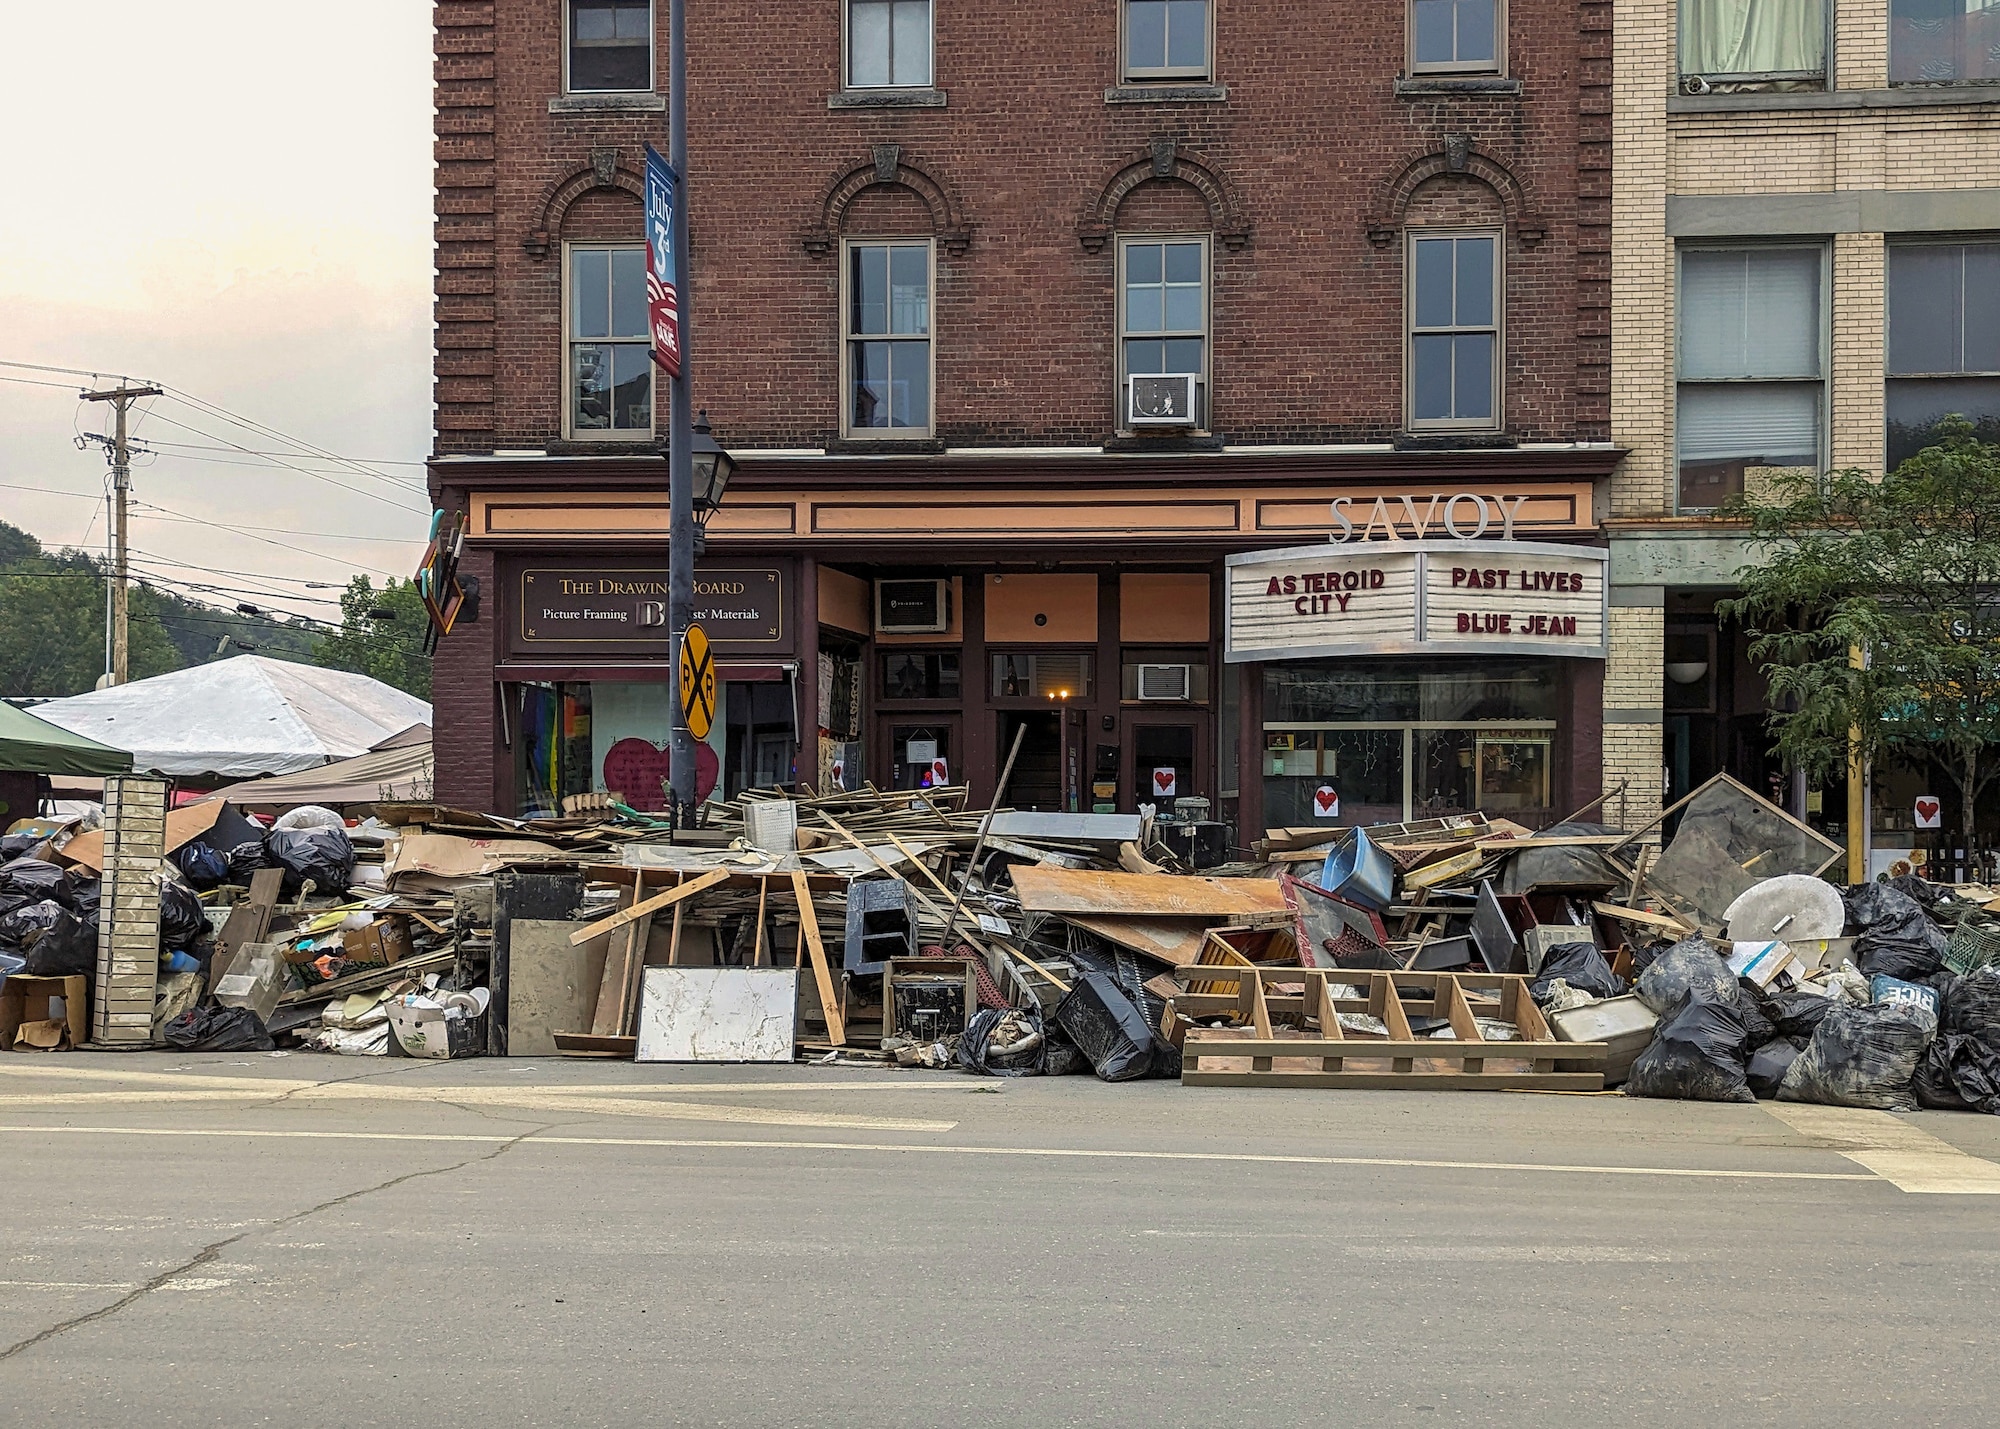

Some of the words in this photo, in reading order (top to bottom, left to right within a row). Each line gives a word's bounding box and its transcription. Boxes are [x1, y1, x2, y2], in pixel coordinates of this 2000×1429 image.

[649, 180, 673, 235] July
[1329, 493, 1530, 543] SAVOY
[559, 579, 593, 595] THE
[599, 579, 671, 595] DRAWIN
[1452, 567, 1510, 590] PAST
[1521, 570, 1584, 592] LIVES
[543, 608, 580, 621] Picture
[583, 608, 627, 622] Framing
[711, 608, 760, 621] Materials
[1294, 593, 1352, 616] CITY
[1457, 612, 1512, 634] BLUE
[1520, 615, 1576, 636] JEAN
[682, 664, 690, 693] R
[706, 672, 714, 701] R
[1886, 986, 1935, 1013] RICE
